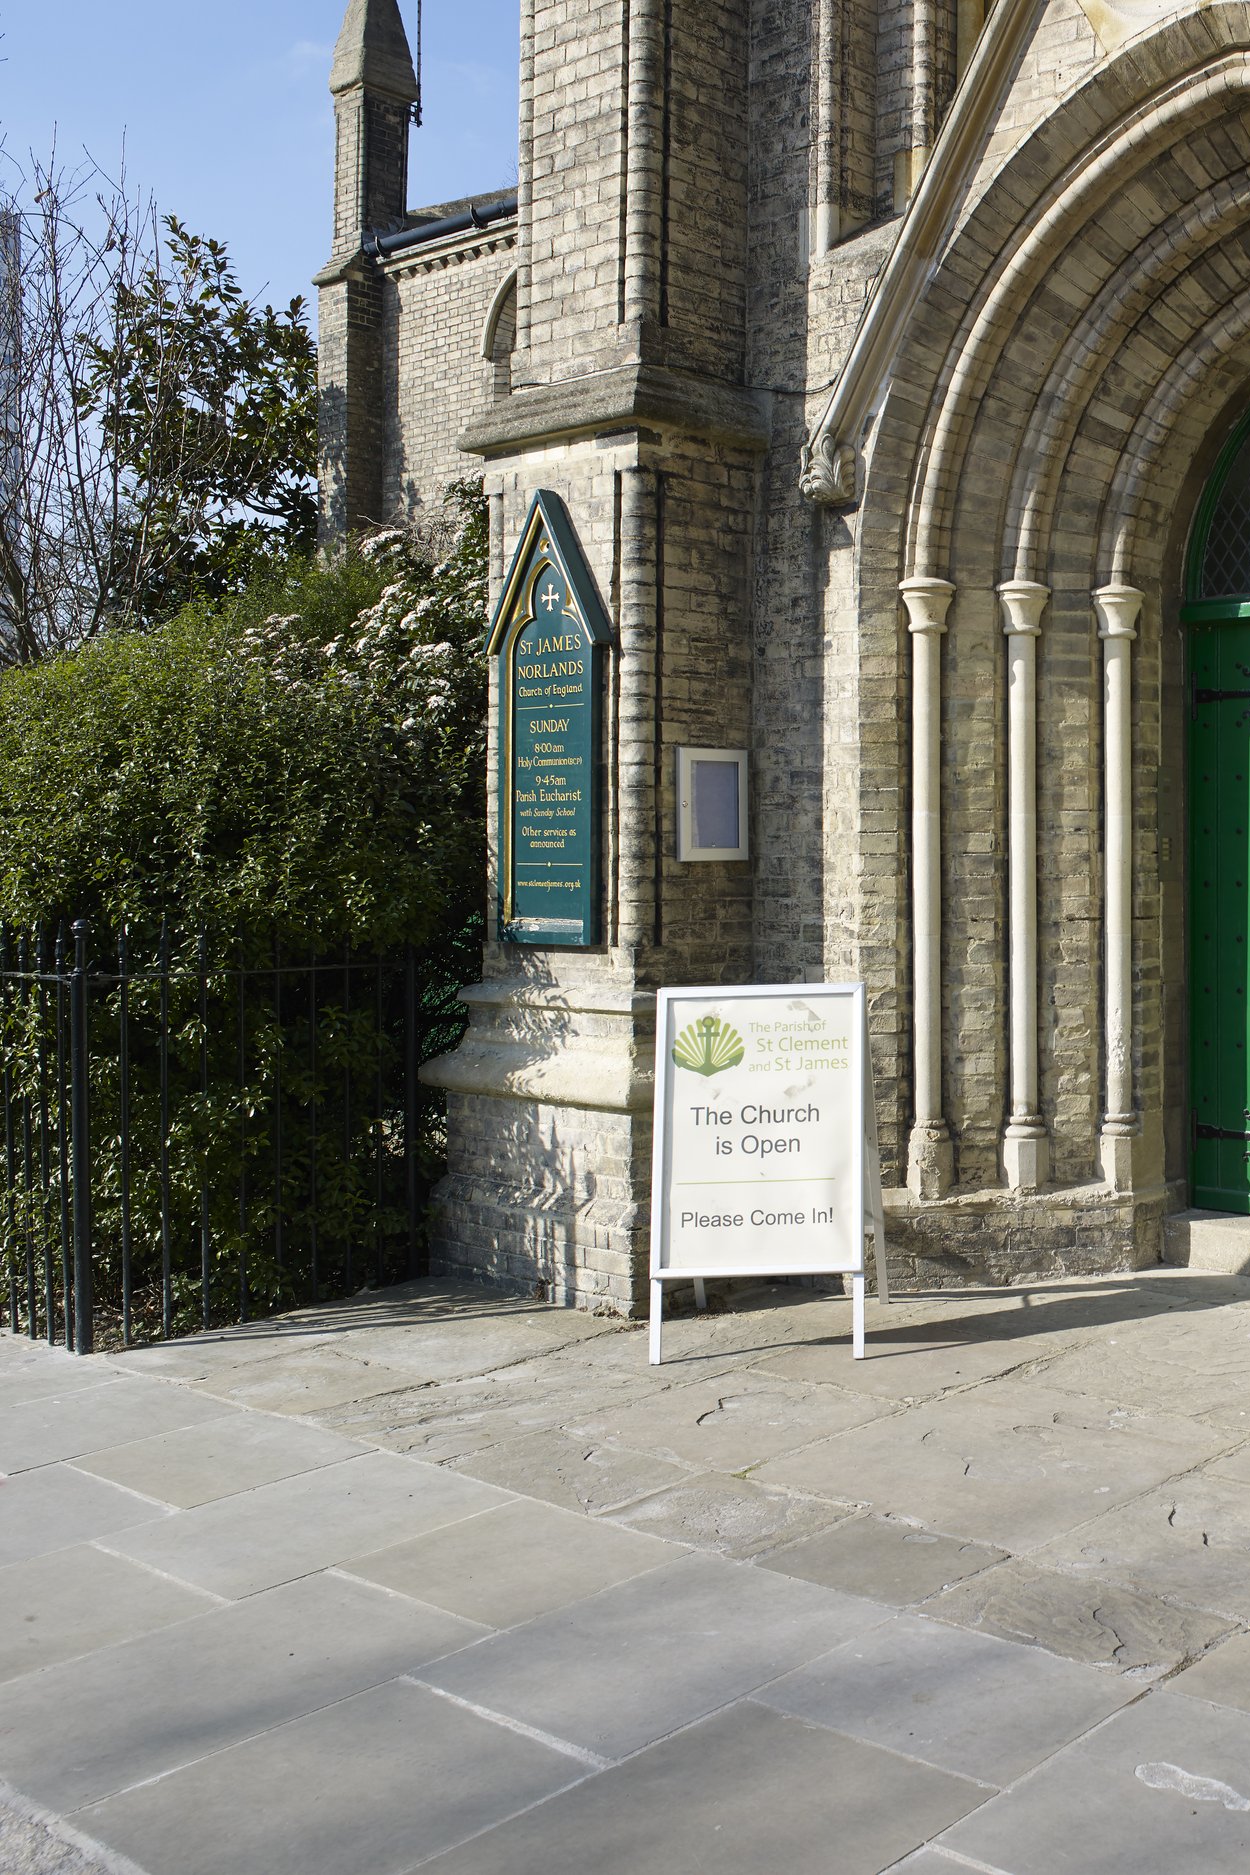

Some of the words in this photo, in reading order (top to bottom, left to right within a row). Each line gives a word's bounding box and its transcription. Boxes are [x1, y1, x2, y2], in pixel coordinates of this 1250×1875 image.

[536, 634, 582, 656] JAMES
[518, 660, 584, 680] NORLANDS
[518, 686, 542, 698] Church
[544, 686, 551, 697] of
[553, 683, 583, 697] England
[530, 719, 570, 734] SUNDAY
[518, 757, 533, 770] Holy
[516, 790, 537, 802] Parish
[540, 789, 582, 802] Eucharist
[520, 809, 532, 817] with
[534, 808, 554, 819] Sunday
[556, 807, 576, 817] School
[522, 826, 542, 837] Other
[544, 828, 567, 836] services
[530, 839, 565, 848] announced
[748, 1022, 771, 1033] The
[775, 1021, 810, 1032] Parish
[813, 1020, 827, 1031] of
[756, 1038, 774, 1053] St
[778, 1036, 849, 1052] Clement
[748, 1061, 771, 1072] and
[775, 1057, 791, 1071] St
[796, 1056, 849, 1070] James
[690, 1106, 733, 1126] The
[740, 1103, 820, 1124] Church
[716, 1137, 733, 1155] is
[741, 1135, 801, 1159] Open
[680, 1211, 744, 1228] Please
[750, 1209, 805, 1226] Come
[812, 1207, 834, 1224] In!
